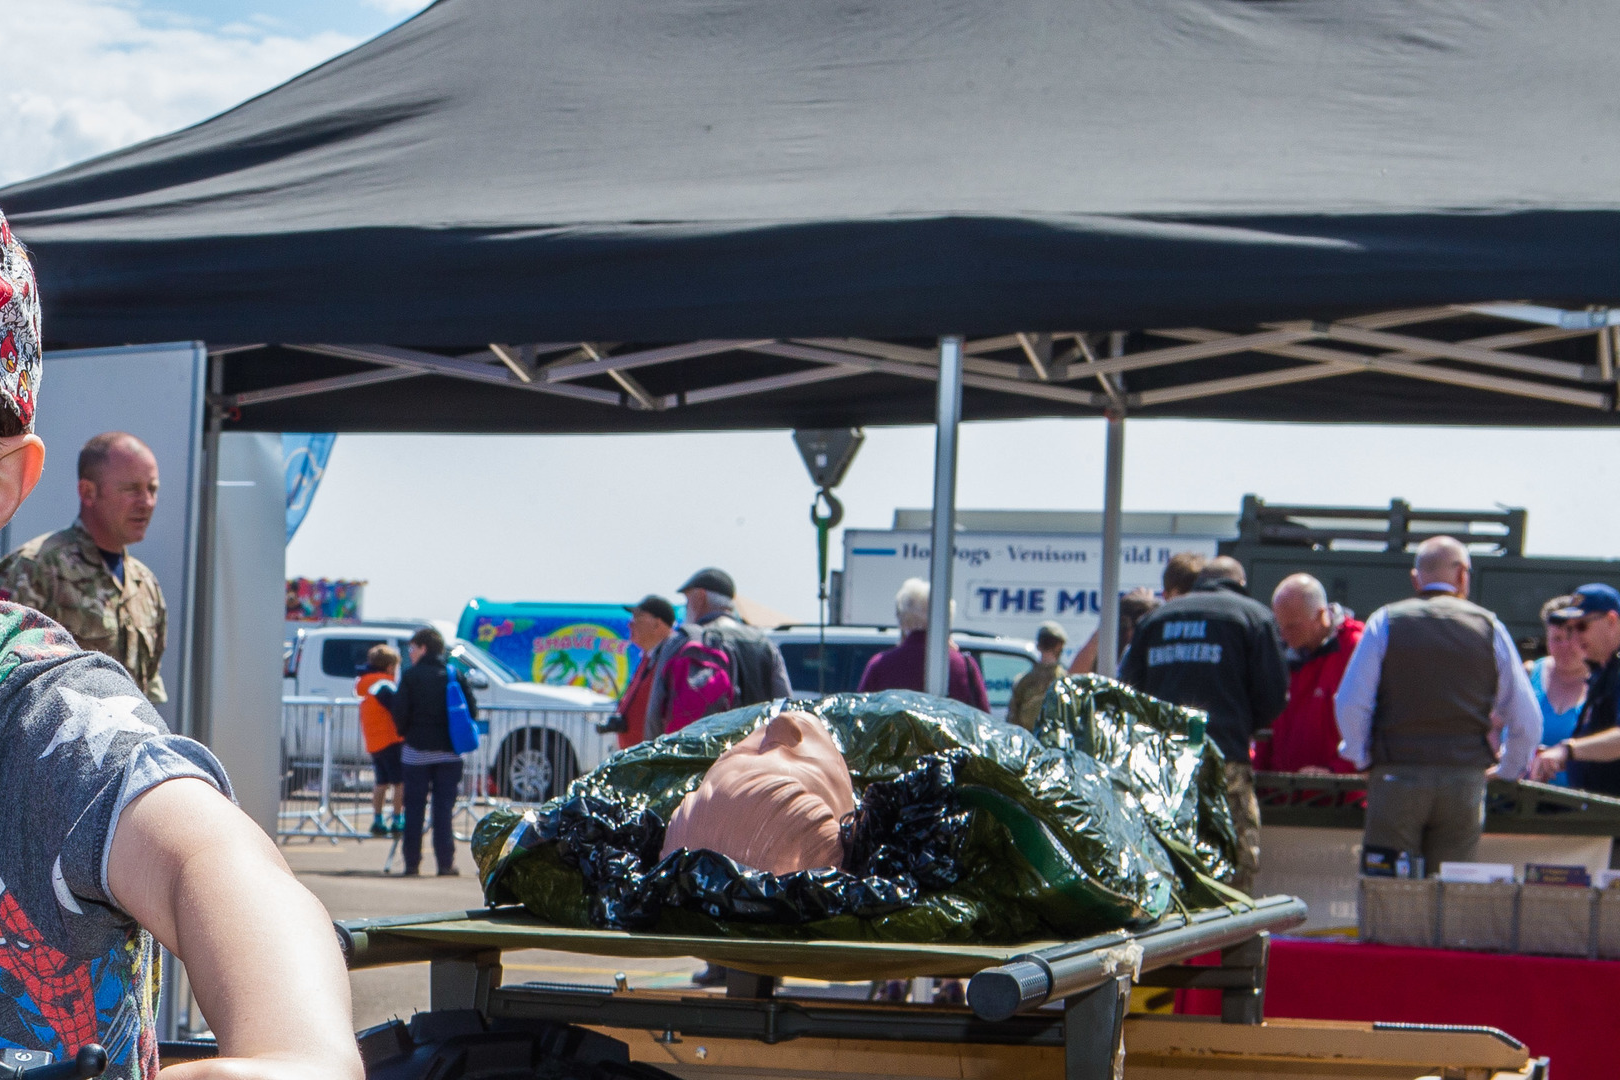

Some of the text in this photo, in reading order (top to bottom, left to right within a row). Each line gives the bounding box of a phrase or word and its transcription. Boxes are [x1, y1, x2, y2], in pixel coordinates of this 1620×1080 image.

[903, 543, 931, 560] Ho
[952, 544, 991, 567] ogs
[1008, 545, 1086, 561] Venison
[1124, 545, 1151, 563] ild
[977, 587, 1045, 612] THE
[532, 635, 630, 655] SHAVE ICE
